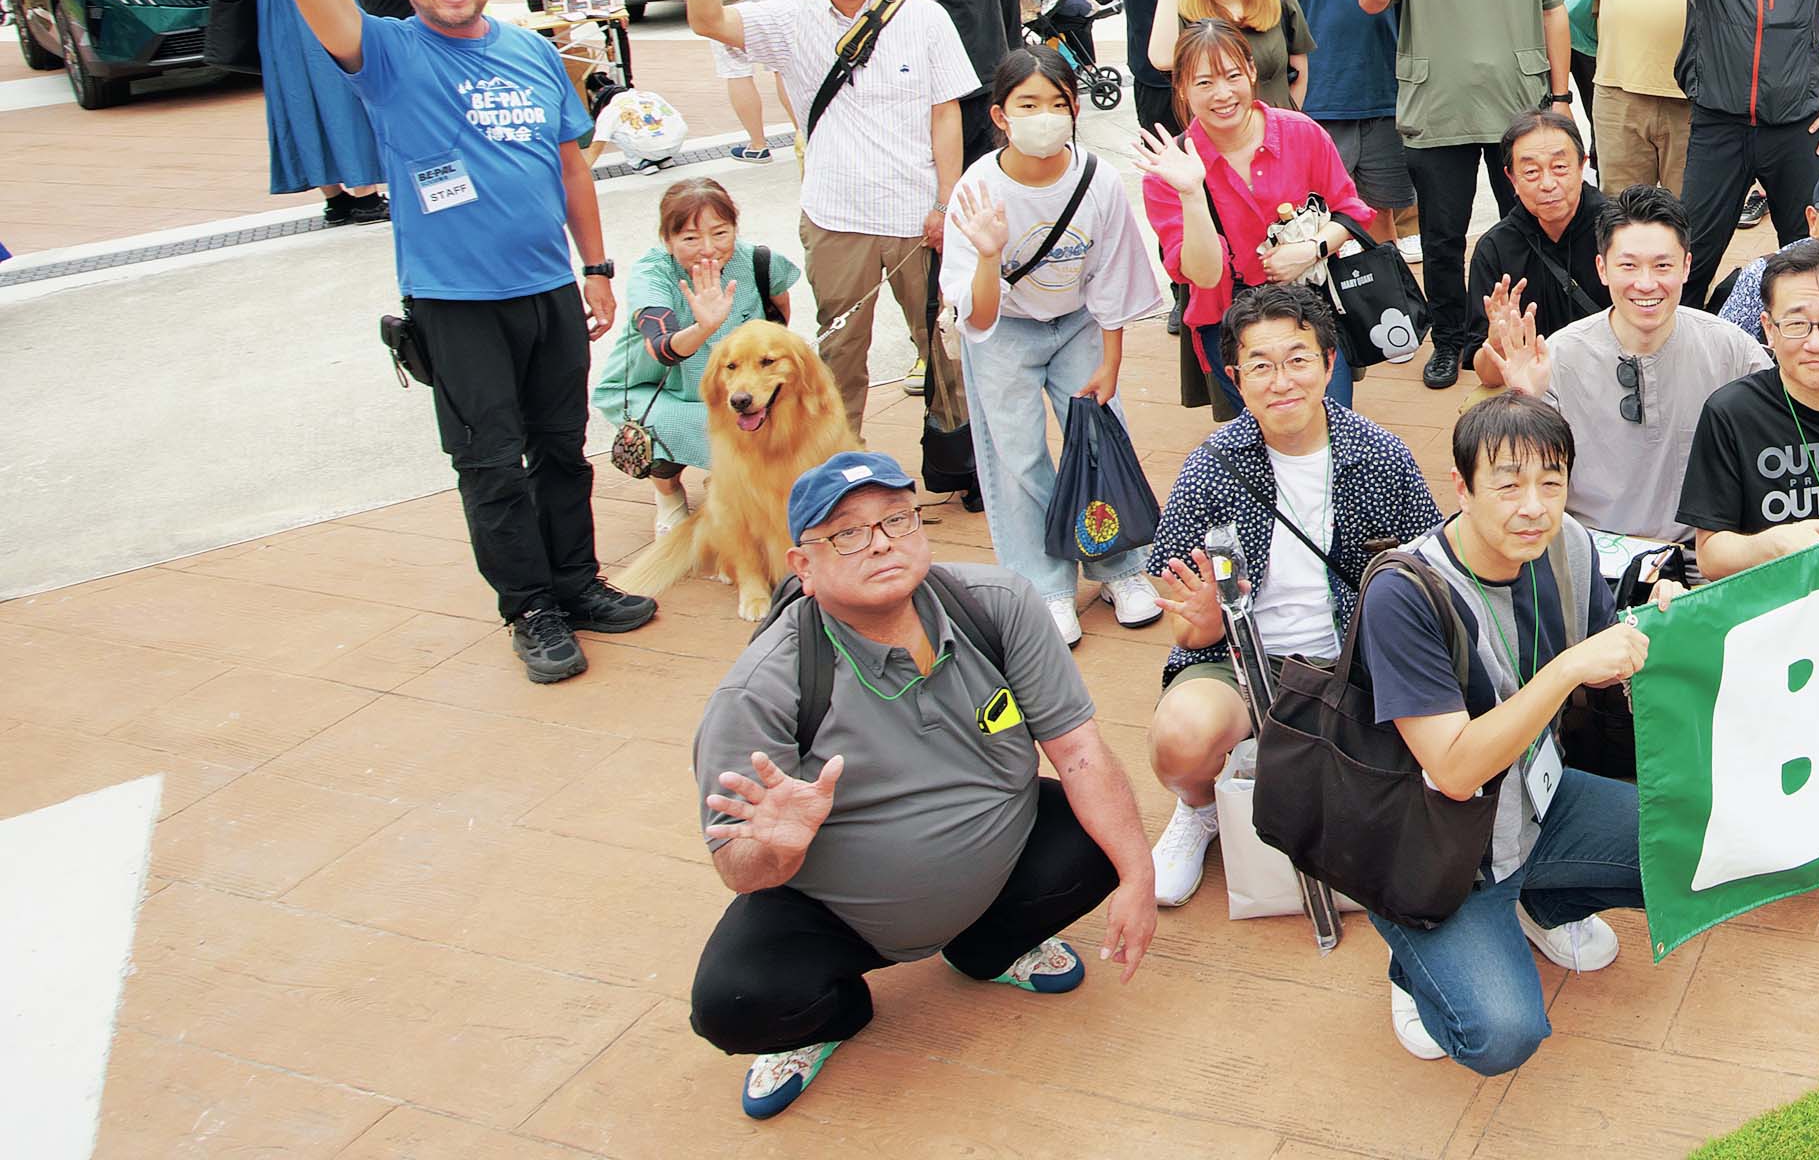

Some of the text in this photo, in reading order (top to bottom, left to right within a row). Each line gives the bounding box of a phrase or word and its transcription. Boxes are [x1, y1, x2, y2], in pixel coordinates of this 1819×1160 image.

[465, 107, 546, 126] OUTDOOR
[418, 165, 456, 181] BE-PAL
[430, 184, 467, 201] STAFF
[1543, 772, 1552, 793] 2
